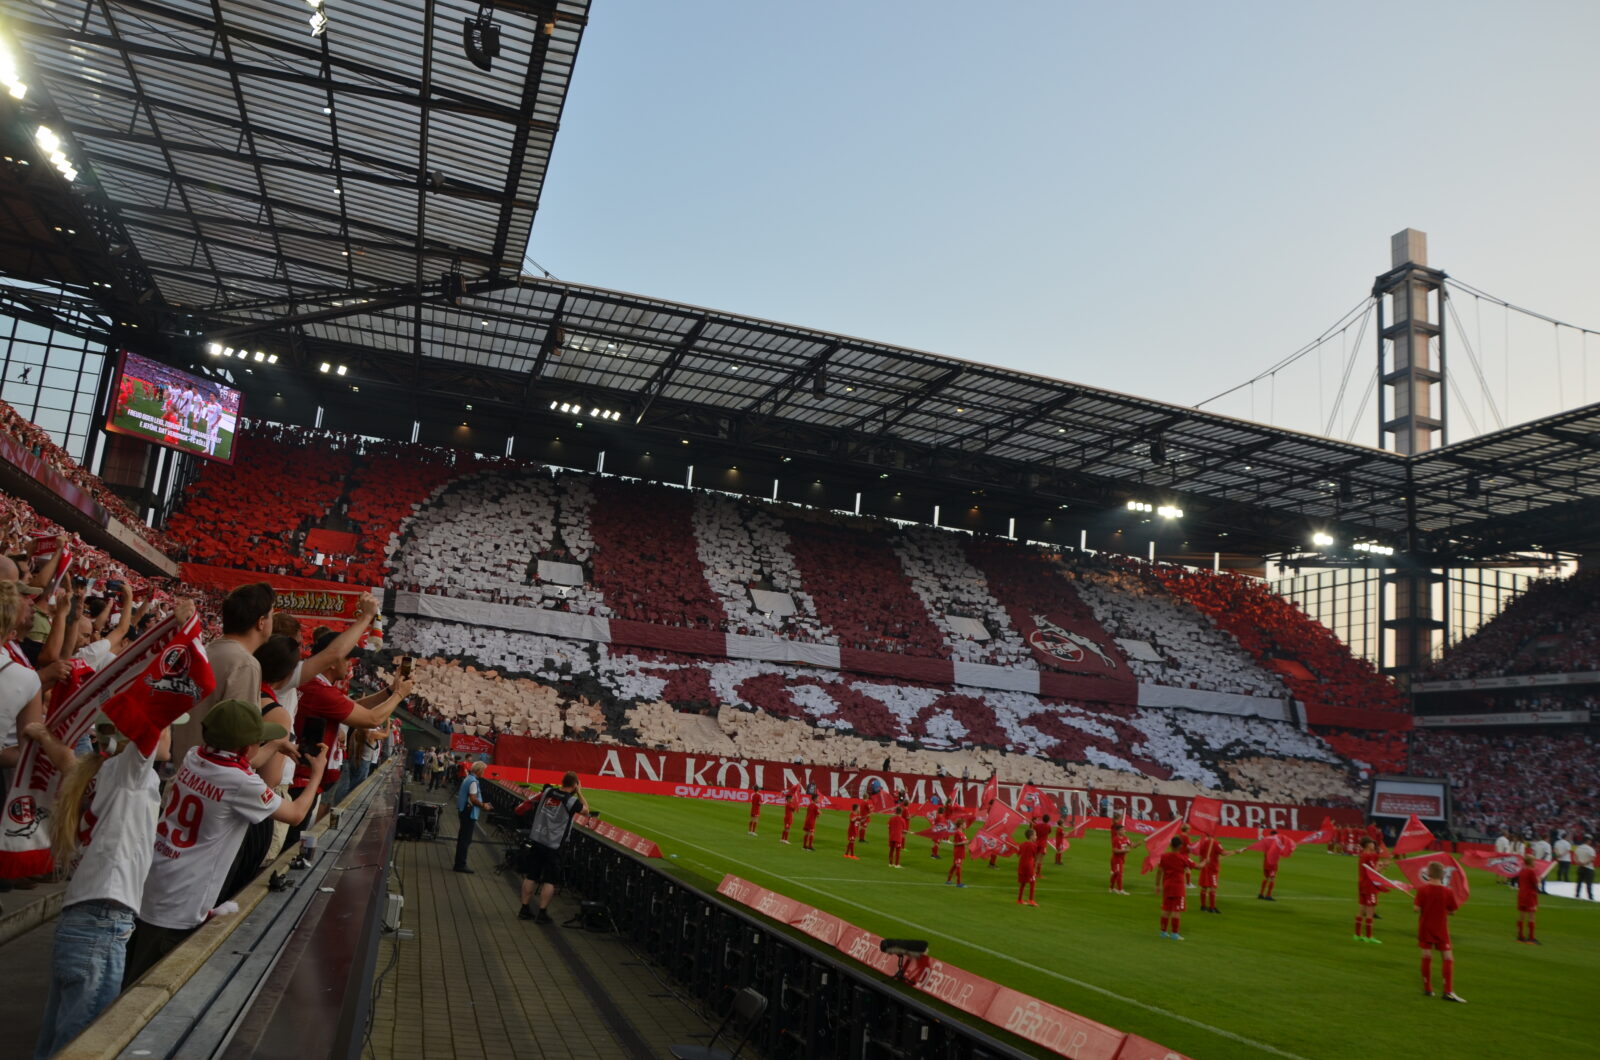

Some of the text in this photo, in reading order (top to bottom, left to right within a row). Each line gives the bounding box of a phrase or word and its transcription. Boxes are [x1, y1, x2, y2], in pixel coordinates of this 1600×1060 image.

[177, 768, 225, 802] ELMANN
[598, 749, 666, 781] AN
[685, 757, 812, 794] KÖLN
[830, 771, 985, 808] KOMMT
[1168, 799, 1298, 831] VRBEI
[703, 787, 748, 801] JUNG
[157, 783, 204, 848] 29
[917, 966, 974, 1007] DERTOUR
[1005, 1006, 1088, 1059] DERTOUR
